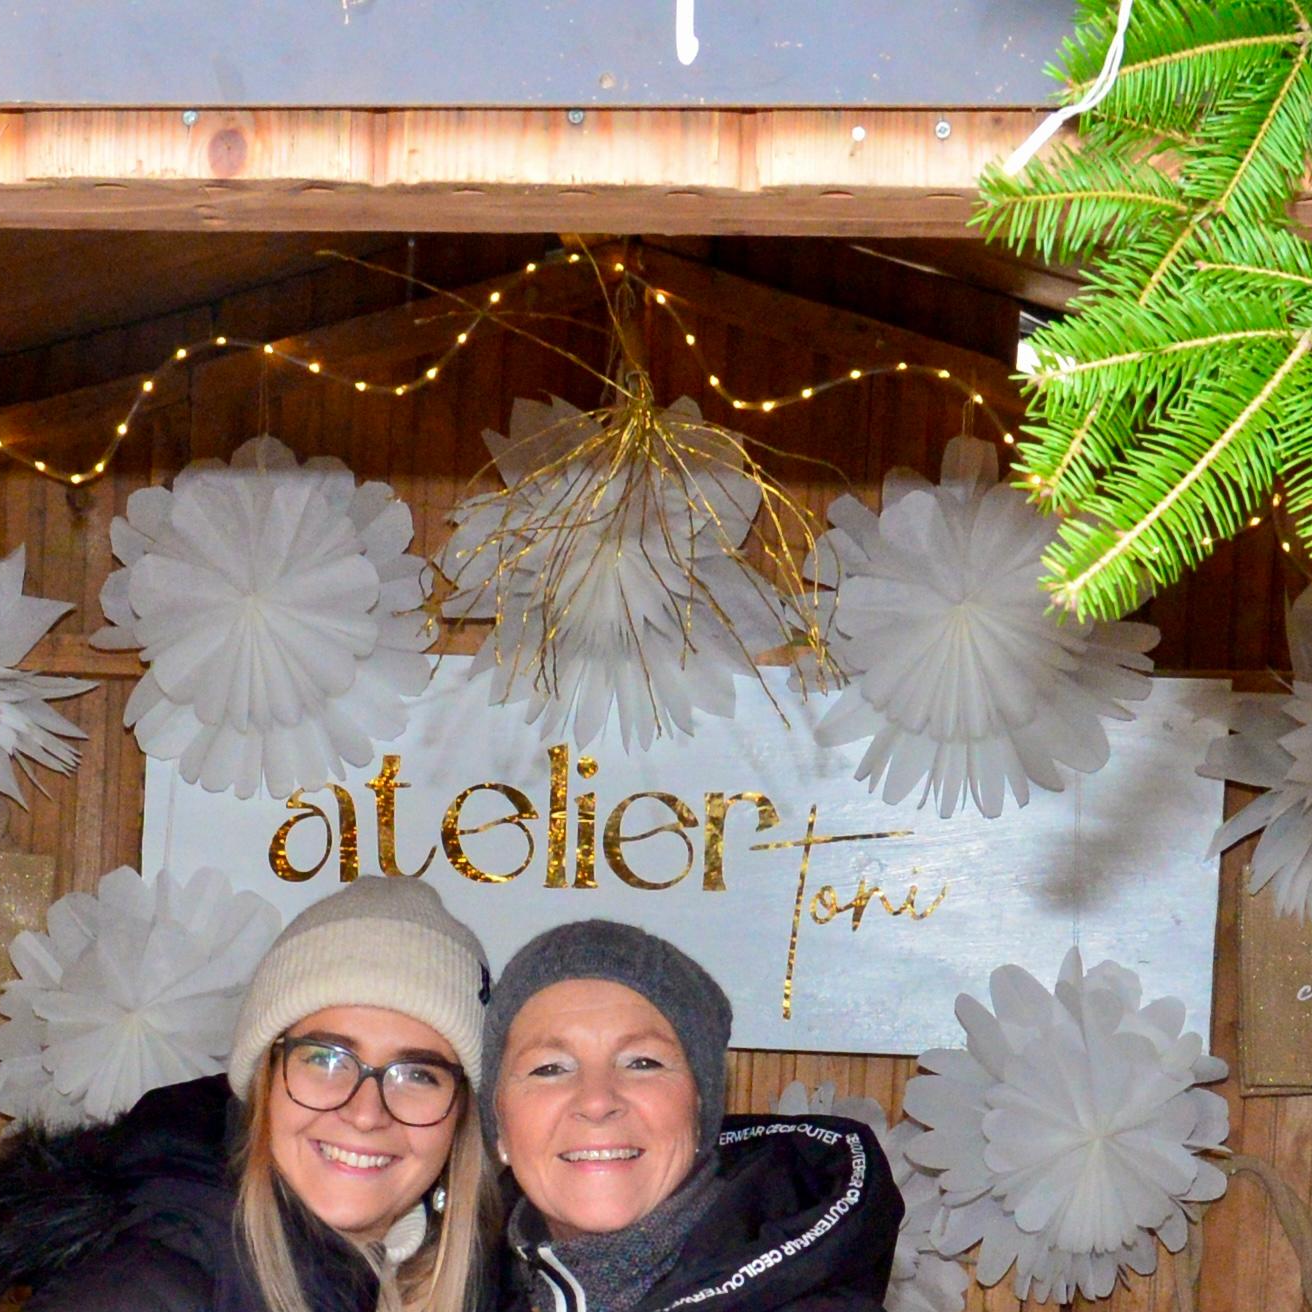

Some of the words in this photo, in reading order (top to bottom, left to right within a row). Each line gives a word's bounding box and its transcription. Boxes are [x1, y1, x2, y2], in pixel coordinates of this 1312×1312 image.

[267, 742, 781, 893] atelier
[748, 803, 950, 1022] Toni
[739, 1249, 784, 1279] CECIL
